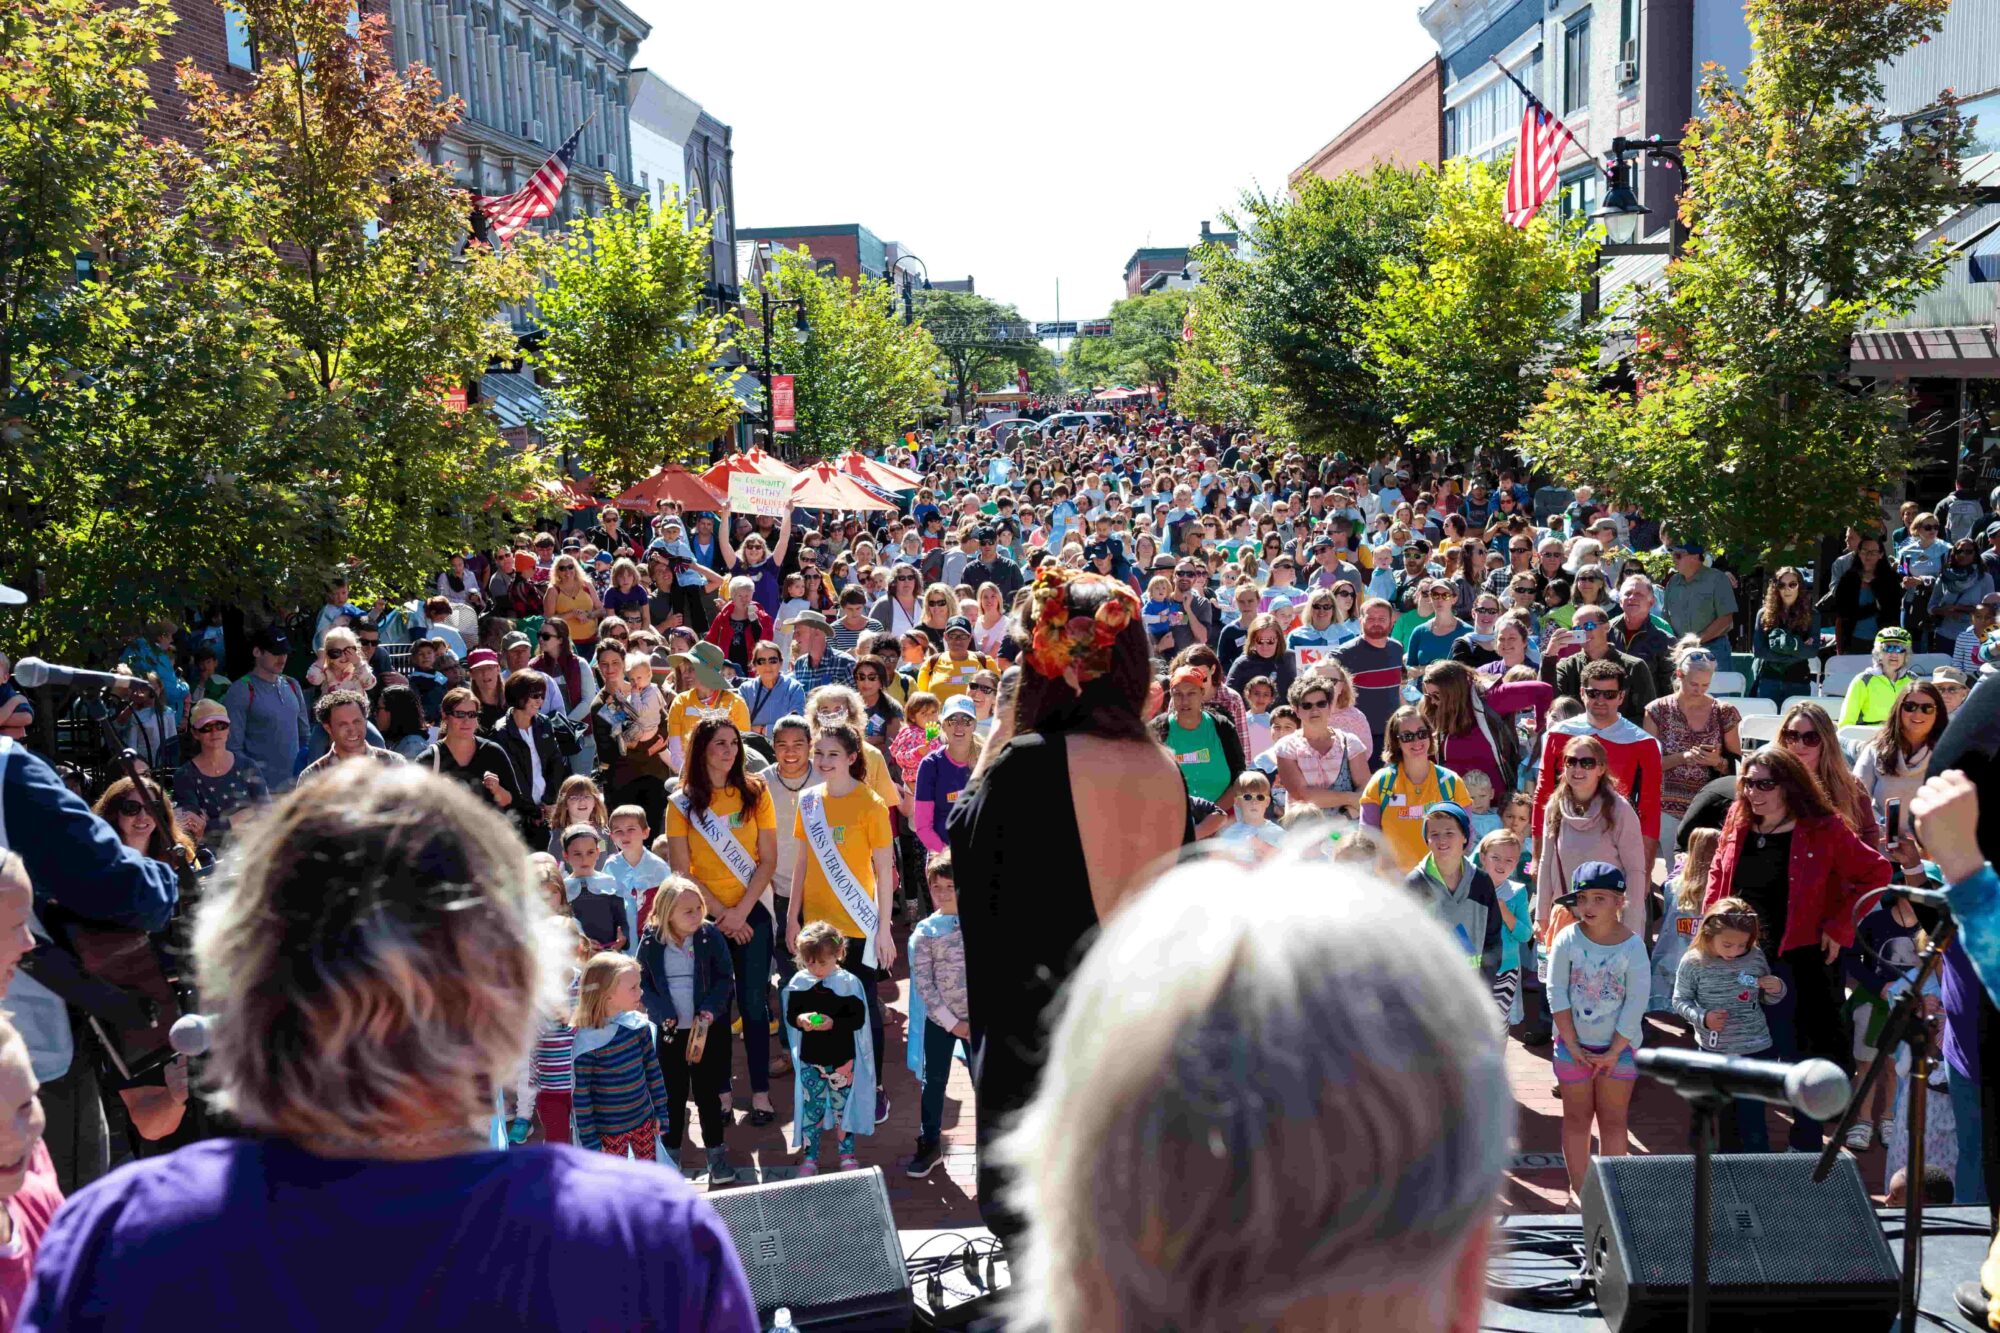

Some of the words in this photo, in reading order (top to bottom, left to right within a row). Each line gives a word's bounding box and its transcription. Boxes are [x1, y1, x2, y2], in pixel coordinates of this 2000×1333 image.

[746, 486, 781, 497] HEALTHY
[756, 505, 782, 515] WELL
[696, 814, 723, 842] MISS
[809, 821, 829, 850] MISS
[823, 848, 865, 910] VERMONT'S
[760, 1236, 777, 1259] JBL
